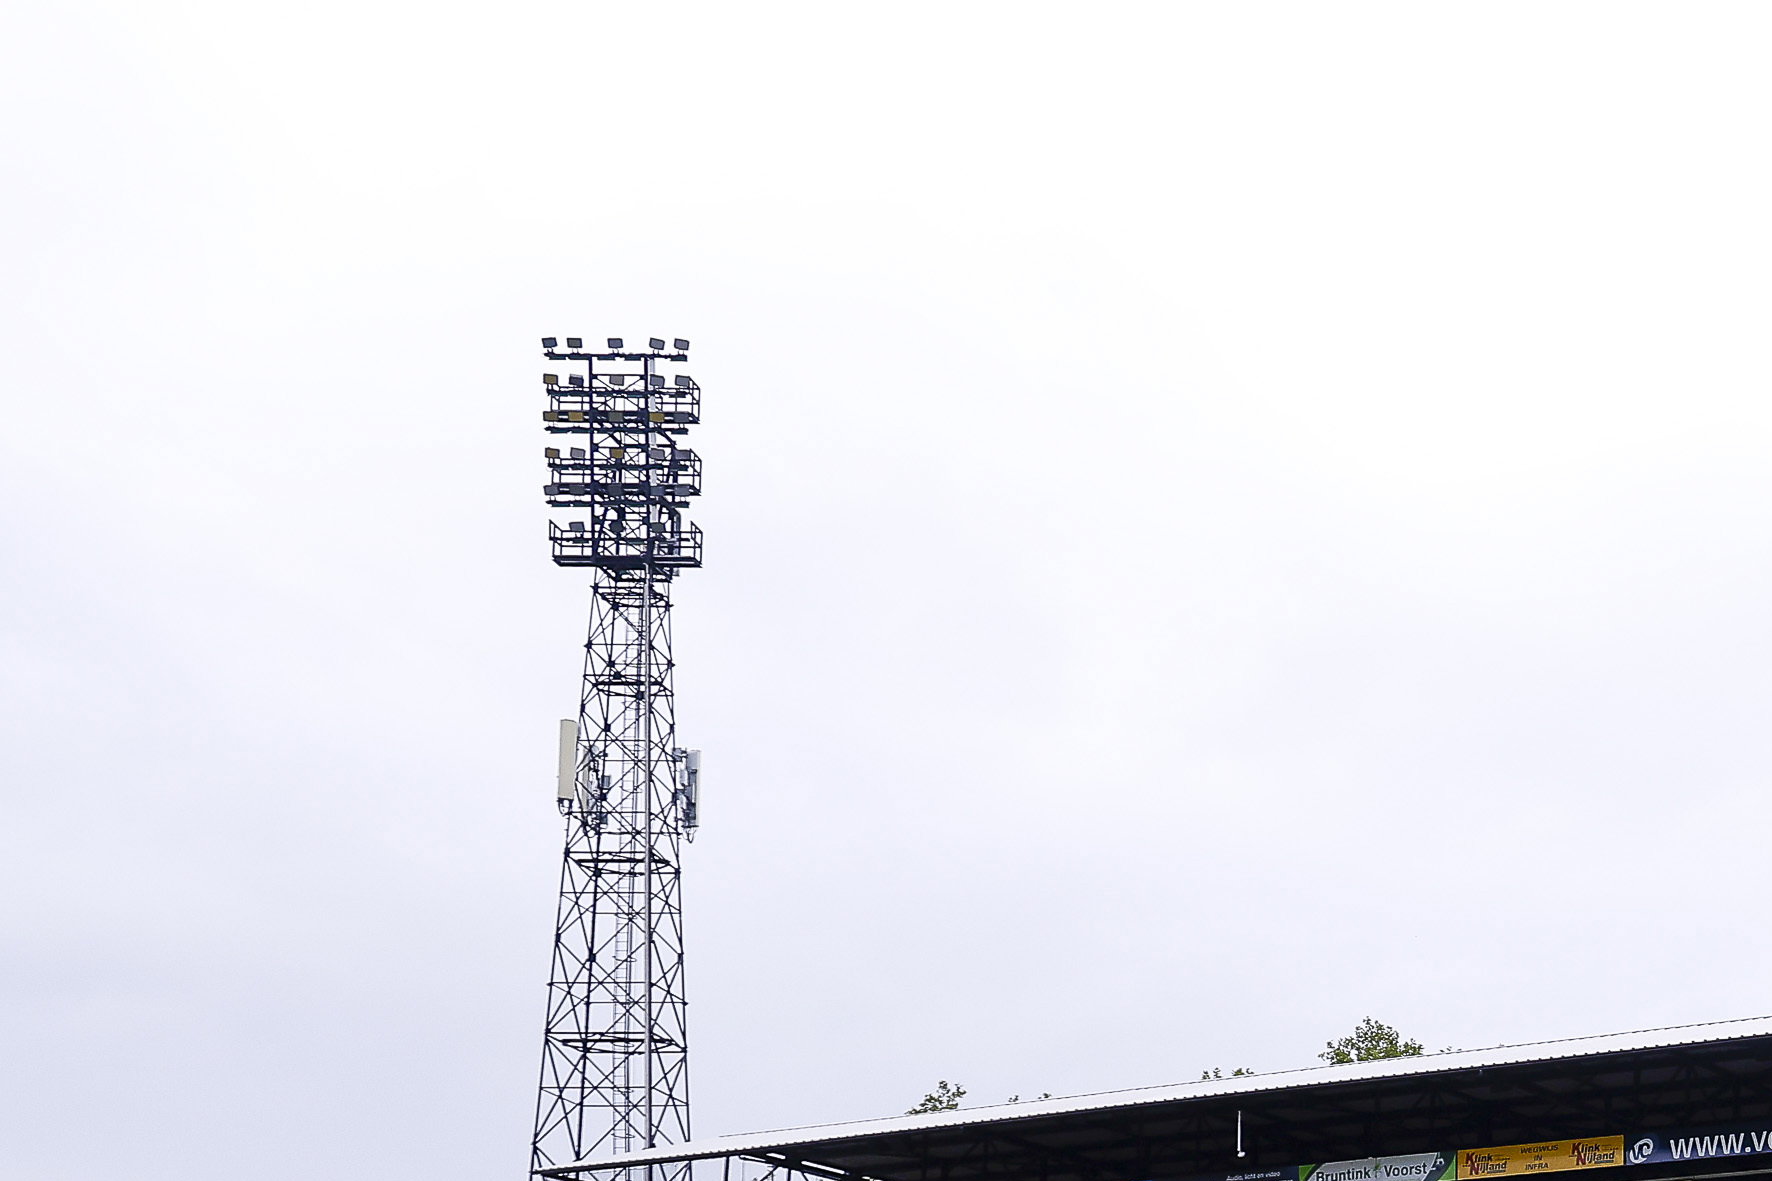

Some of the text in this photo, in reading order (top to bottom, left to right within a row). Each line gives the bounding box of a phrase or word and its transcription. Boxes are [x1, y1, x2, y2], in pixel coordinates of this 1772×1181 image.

[1520, 1144, 1559, 1154] WEGWIJS
[1572, 1141, 1600, 1154] Klink
[1465, 1151, 1493, 1164] Klink
[1575, 1150, 1615, 1166] Nijland
[1384, 1161, 1427, 1178] Voorst
[1469, 1161, 1507, 1176] Nijland
[1525, 1162, 1549, 1171] INFRA
